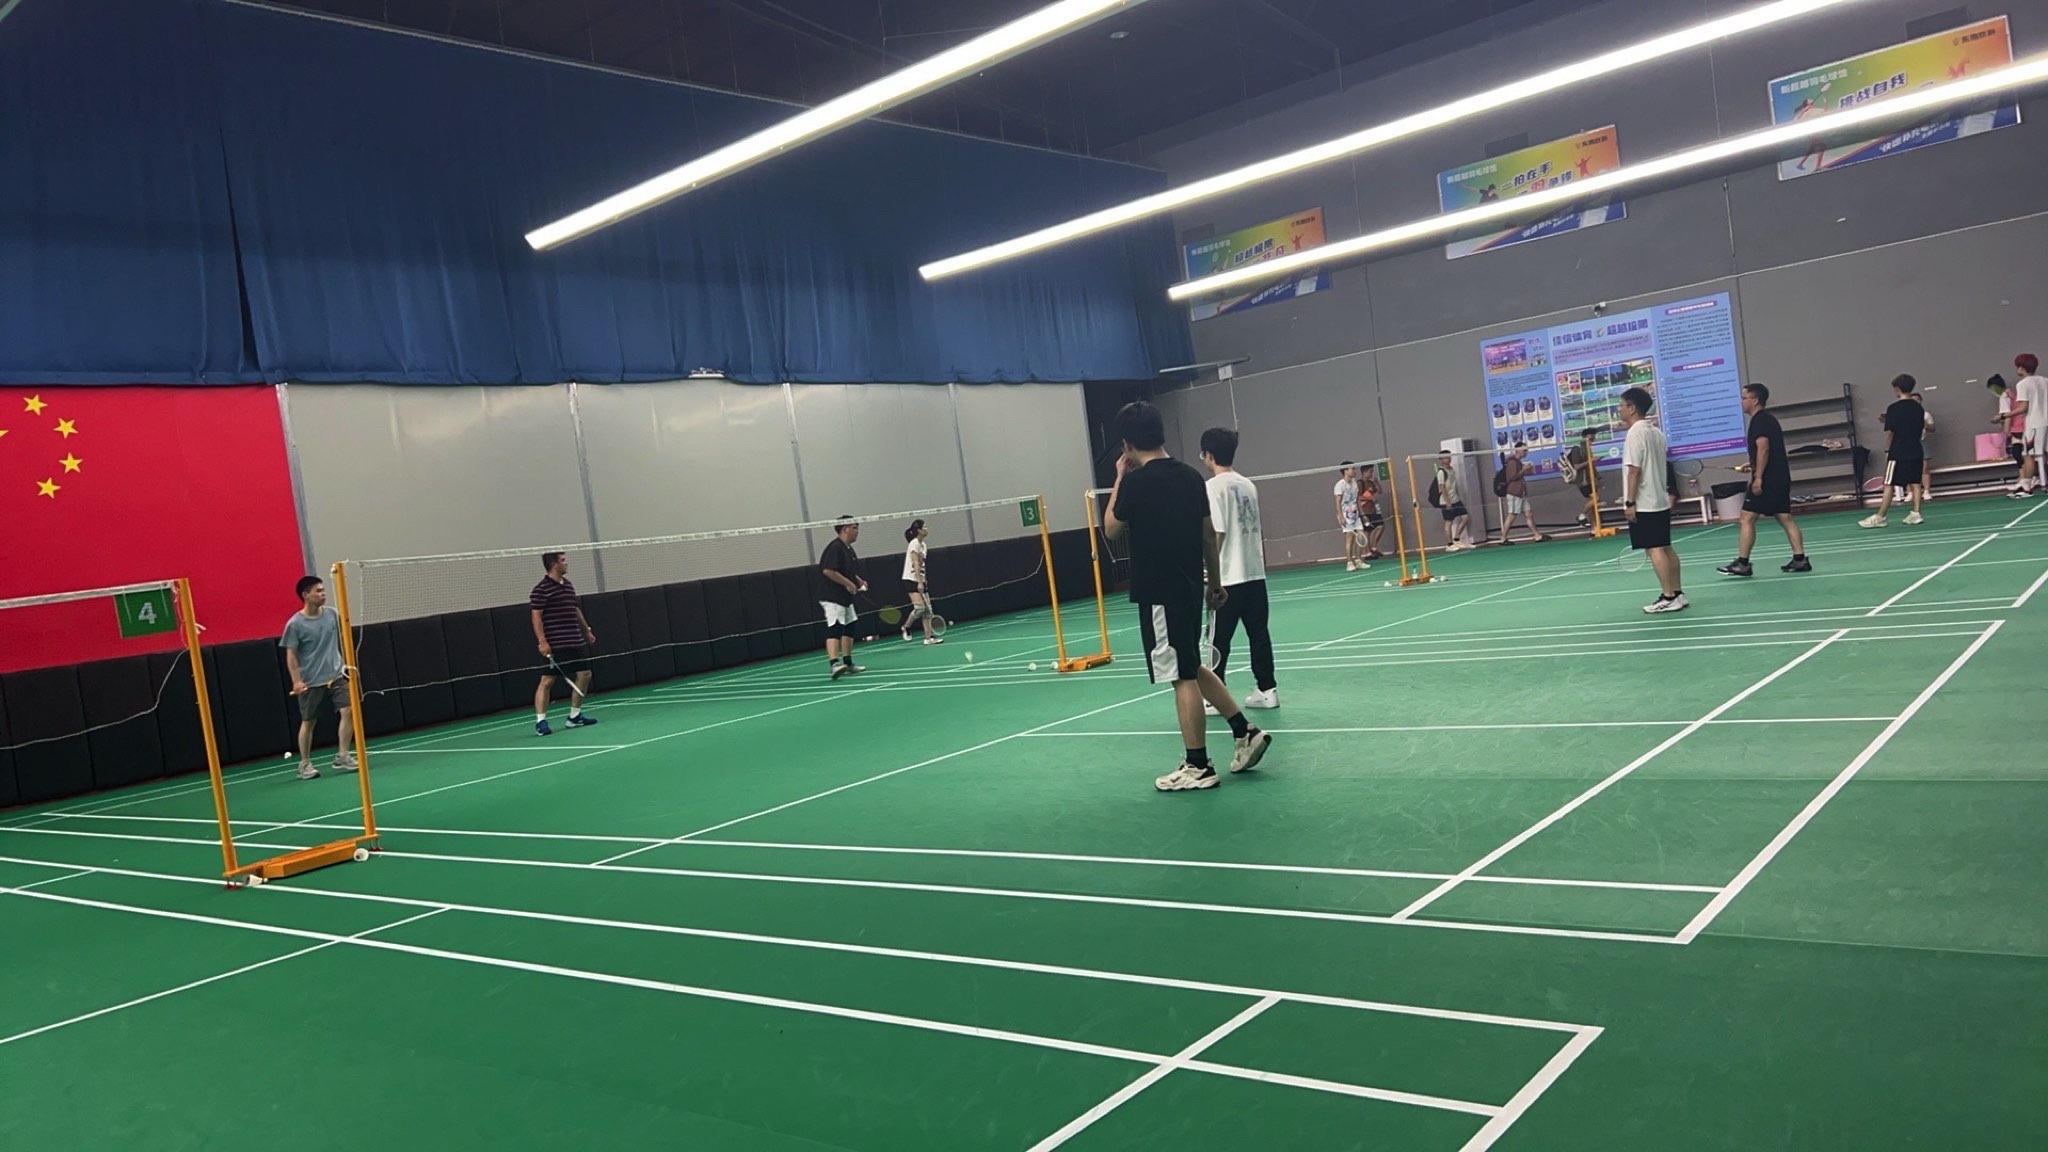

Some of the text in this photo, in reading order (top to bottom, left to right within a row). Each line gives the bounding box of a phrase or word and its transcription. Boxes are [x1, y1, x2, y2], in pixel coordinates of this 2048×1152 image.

[1839, 72, 1905, 109] 挑战自我
[1501, 160, 1552, 191] 一拍在手
[1026, 507, 1035, 521] 3
[138, 602, 157, 625] 4
